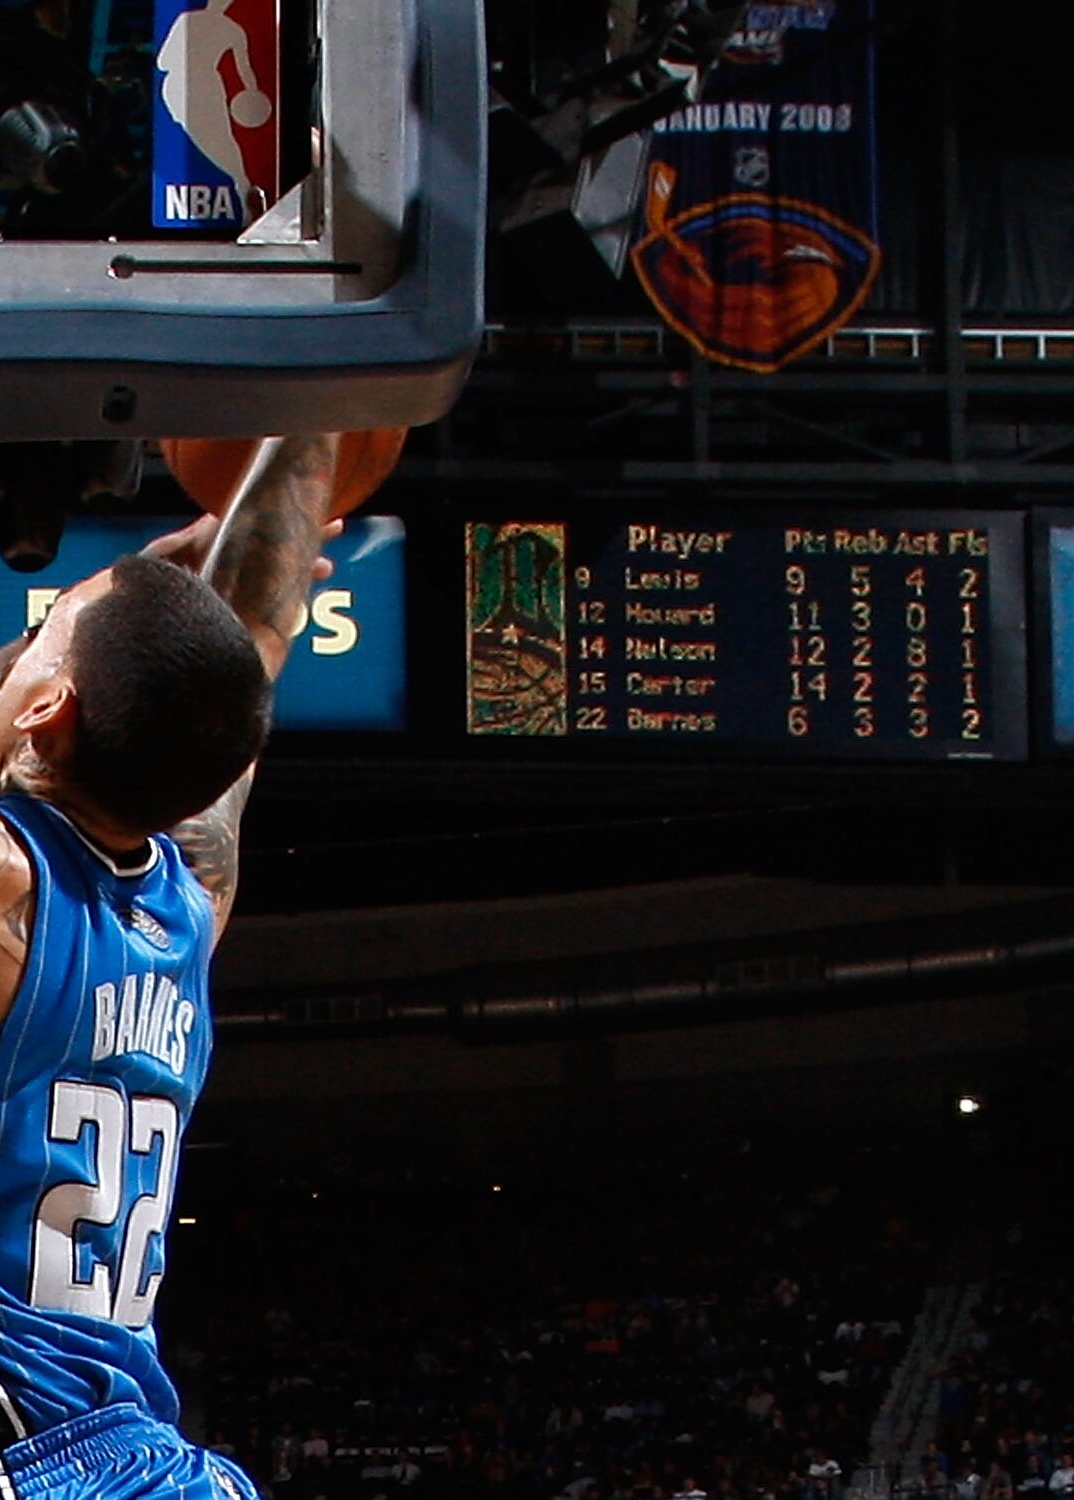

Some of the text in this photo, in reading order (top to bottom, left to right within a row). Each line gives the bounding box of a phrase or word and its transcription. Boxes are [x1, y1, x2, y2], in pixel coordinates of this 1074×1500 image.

[165, 184, 235, 221] NBA
[628, 525, 989, 559] Player Pts Reb Ast Fls
[785, 565, 806, 595] 9
[850, 566, 871, 596] 5
[905, 567, 926, 597] 4
[958, 568, 977, 598] 2
[625, 601, 716, 625] Howard
[788, 602, 822, 631] 11
[851, 602, 872, 632] 3
[906, 602, 927, 632] 0
[960, 603, 975, 633] 1
[789, 636, 826, 667] 12
[852, 637, 873, 667] 2
[907, 637, 927, 667] 8
[960, 638, 975, 668] 1
[578, 671, 976, 703] 15 Carter 14 2 2 1
[576, 706, 981, 739] 22 Barnes 6 3 3 2
[30, 1082, 177, 1328] 22
